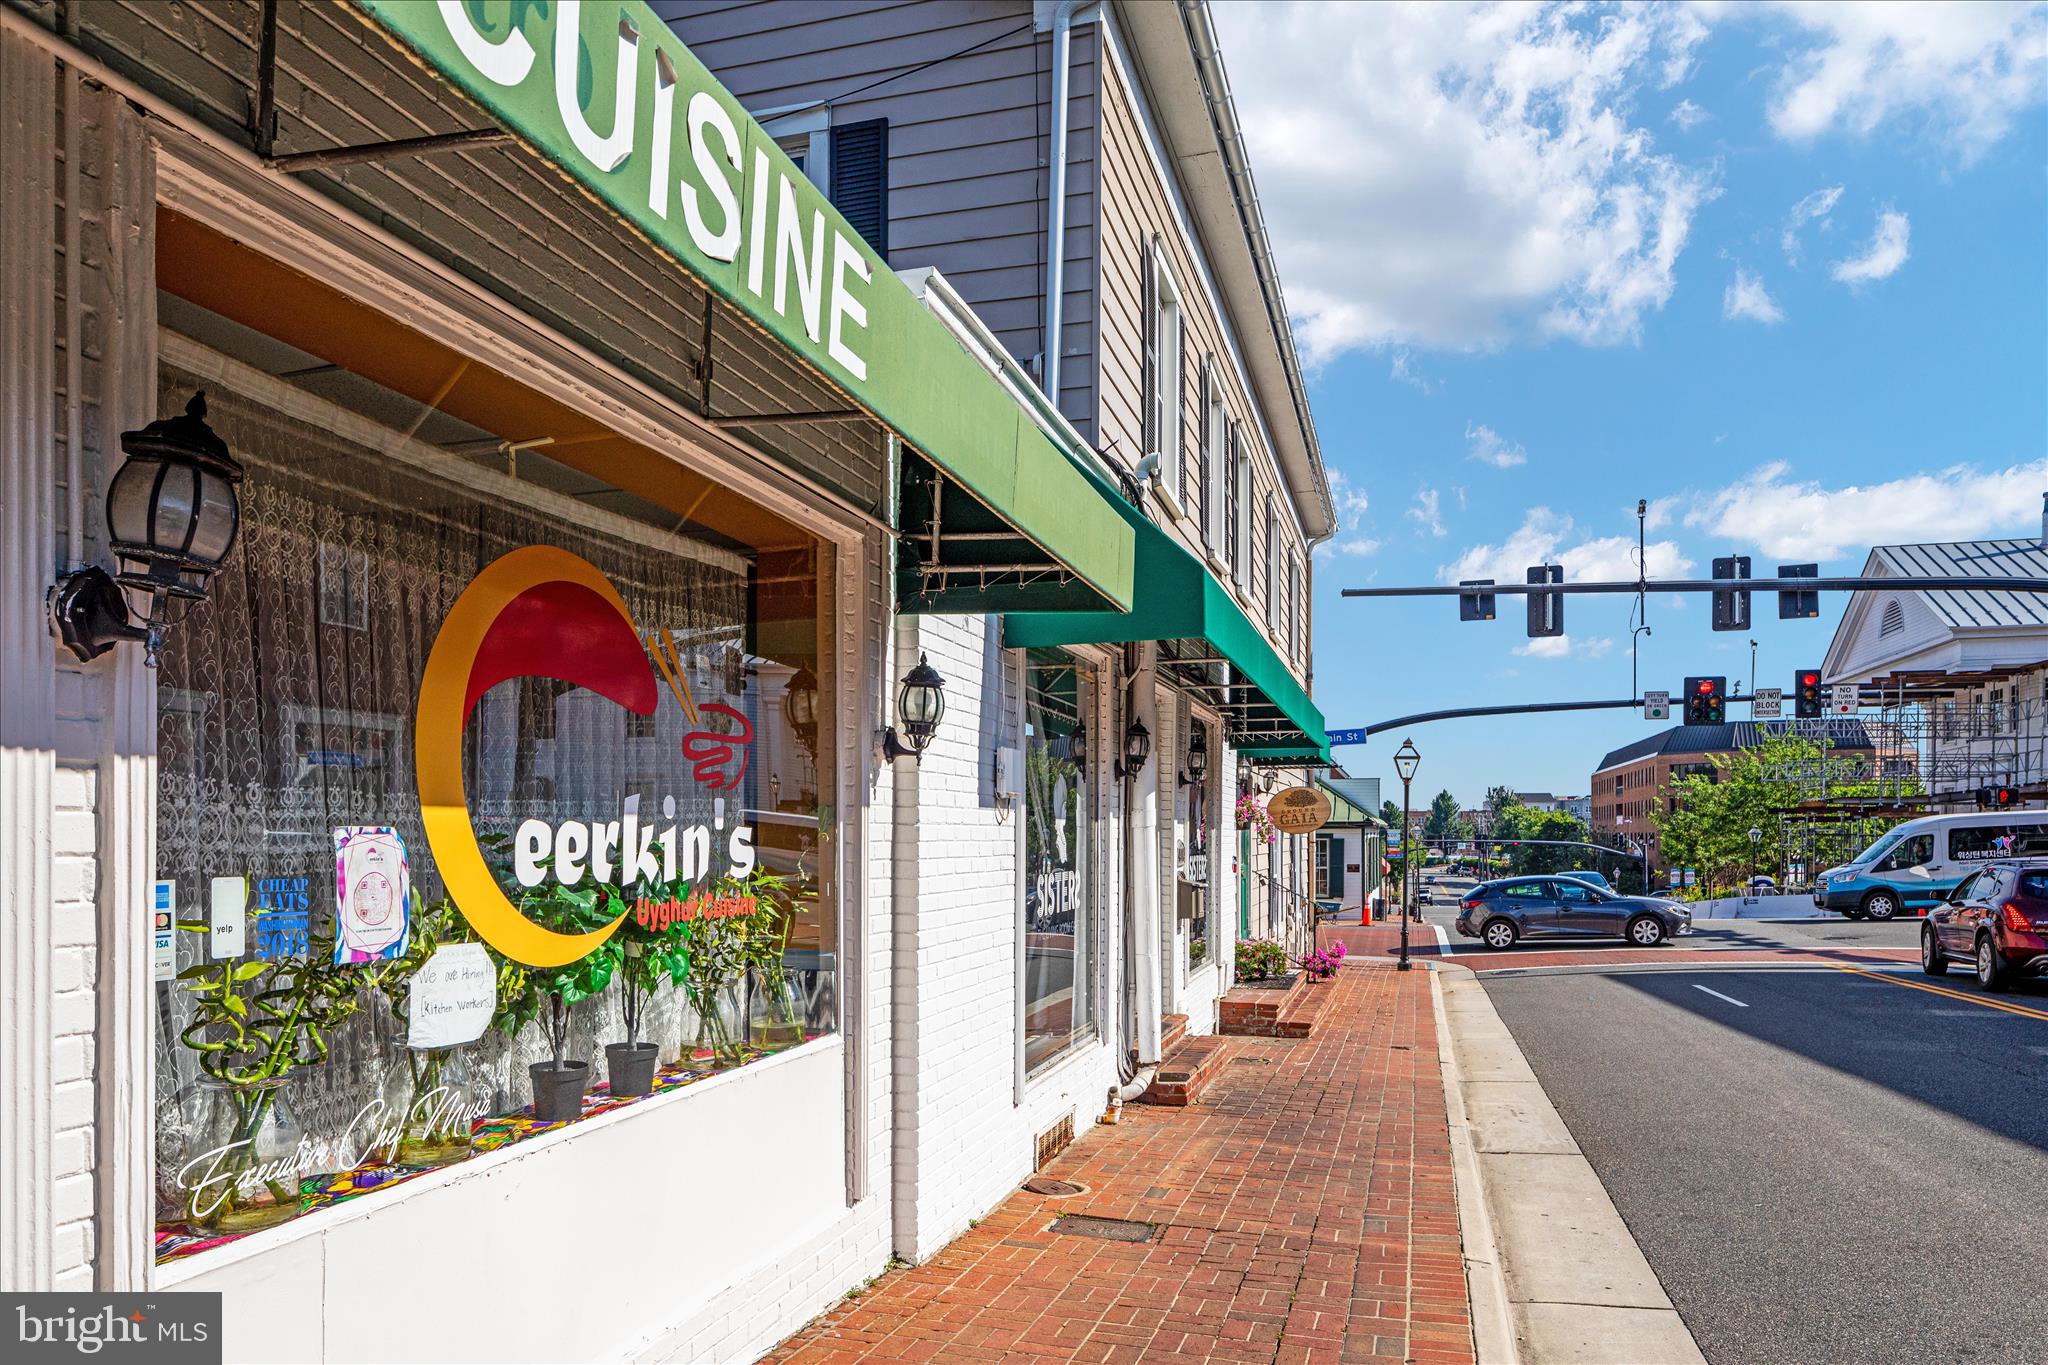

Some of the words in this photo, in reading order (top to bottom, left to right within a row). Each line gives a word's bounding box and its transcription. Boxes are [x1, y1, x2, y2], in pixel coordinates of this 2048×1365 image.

[1767, 691, 1780, 699] NOT
[1756, 701, 1780, 709] BLOCK
[1329, 733, 1342, 742] in
[1346, 732, 1358, 741] St
[1280, 812, 1318, 825] GAIA
[258, 878, 309, 892] CHEAP
[1037, 869, 1081, 917] SISTERS
[259, 892, 309, 911] EATS
[636, 895, 699, 932] Uyghur
[702, 890, 757, 921] Cuisine
[216, 924, 233, 934] yelp
[256, 930, 309, 959] 2018
[419, 965, 436, 984] We
[445, 969, 458, 982] are
[177, 1132, 331, 1218] Executive
[339, 1098, 411, 1171] Chef
